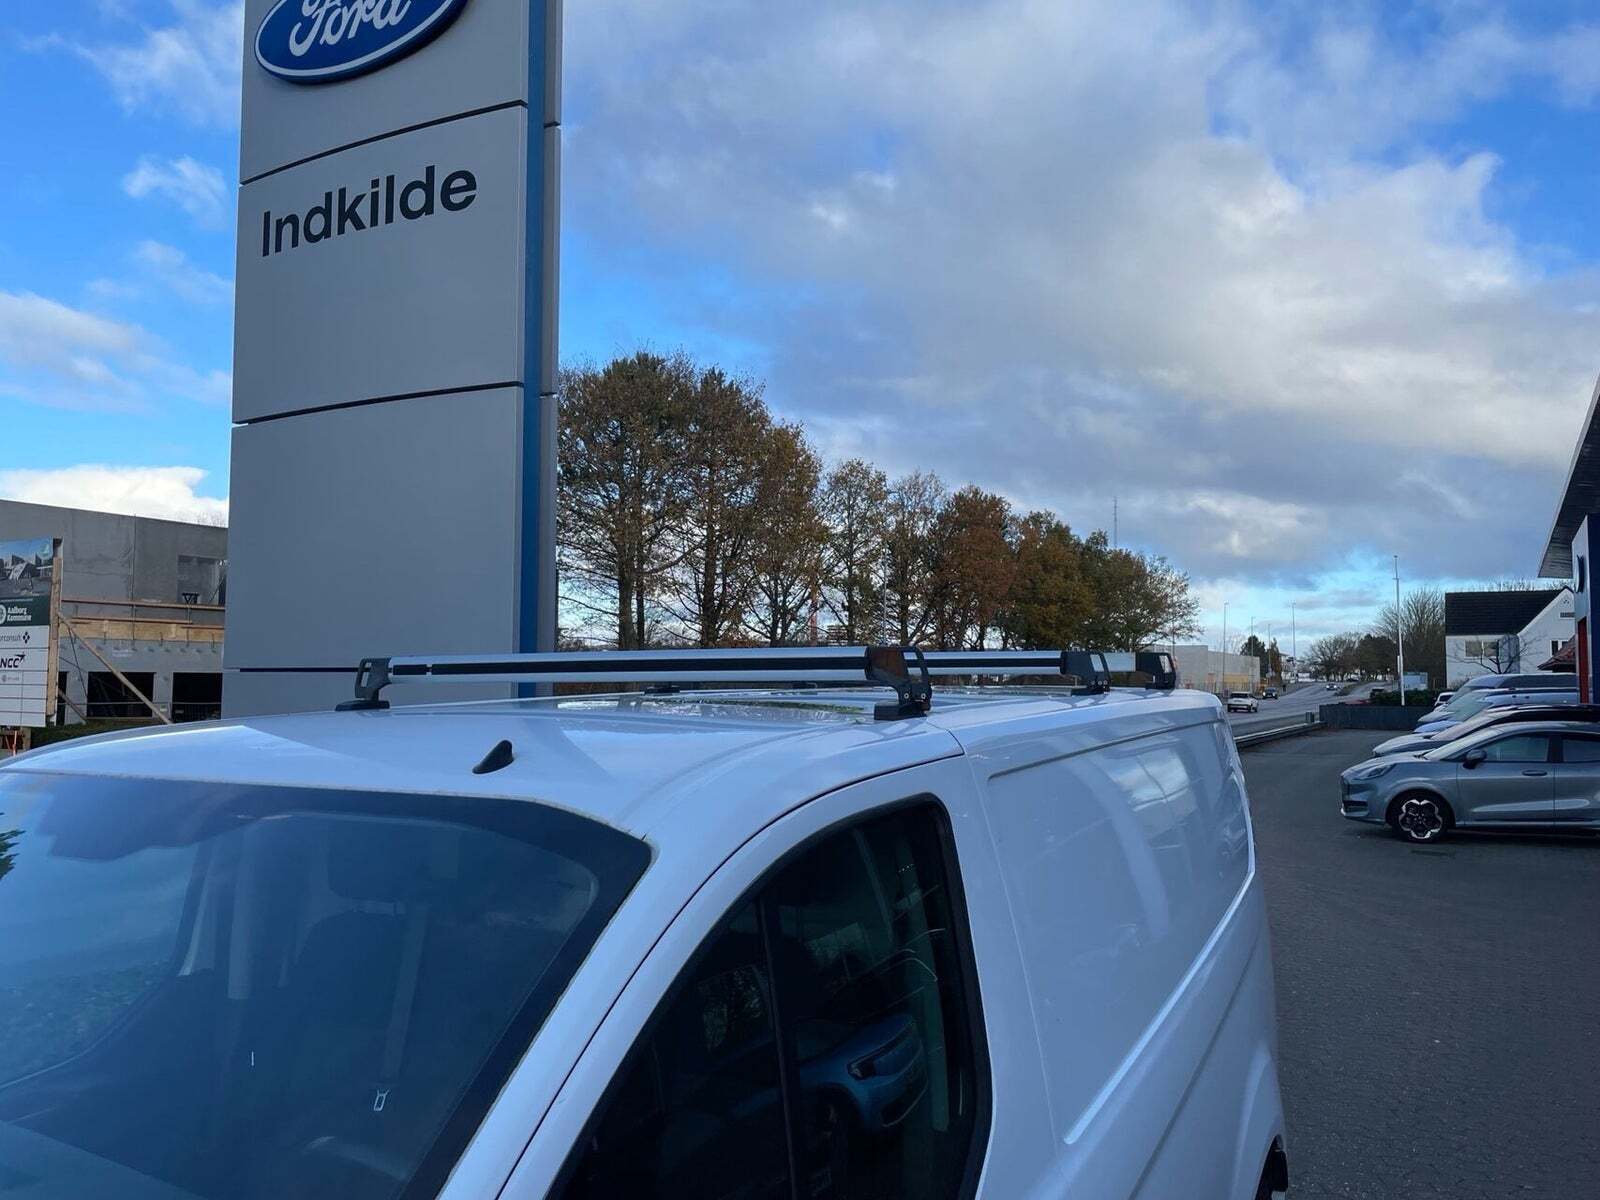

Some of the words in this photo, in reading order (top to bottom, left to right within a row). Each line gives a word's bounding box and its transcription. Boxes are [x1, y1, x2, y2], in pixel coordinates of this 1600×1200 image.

[289, 0, 412, 57] Ford
[262, 165, 477, 257] Indkilde
[0, 657, 20, 669] NCC
